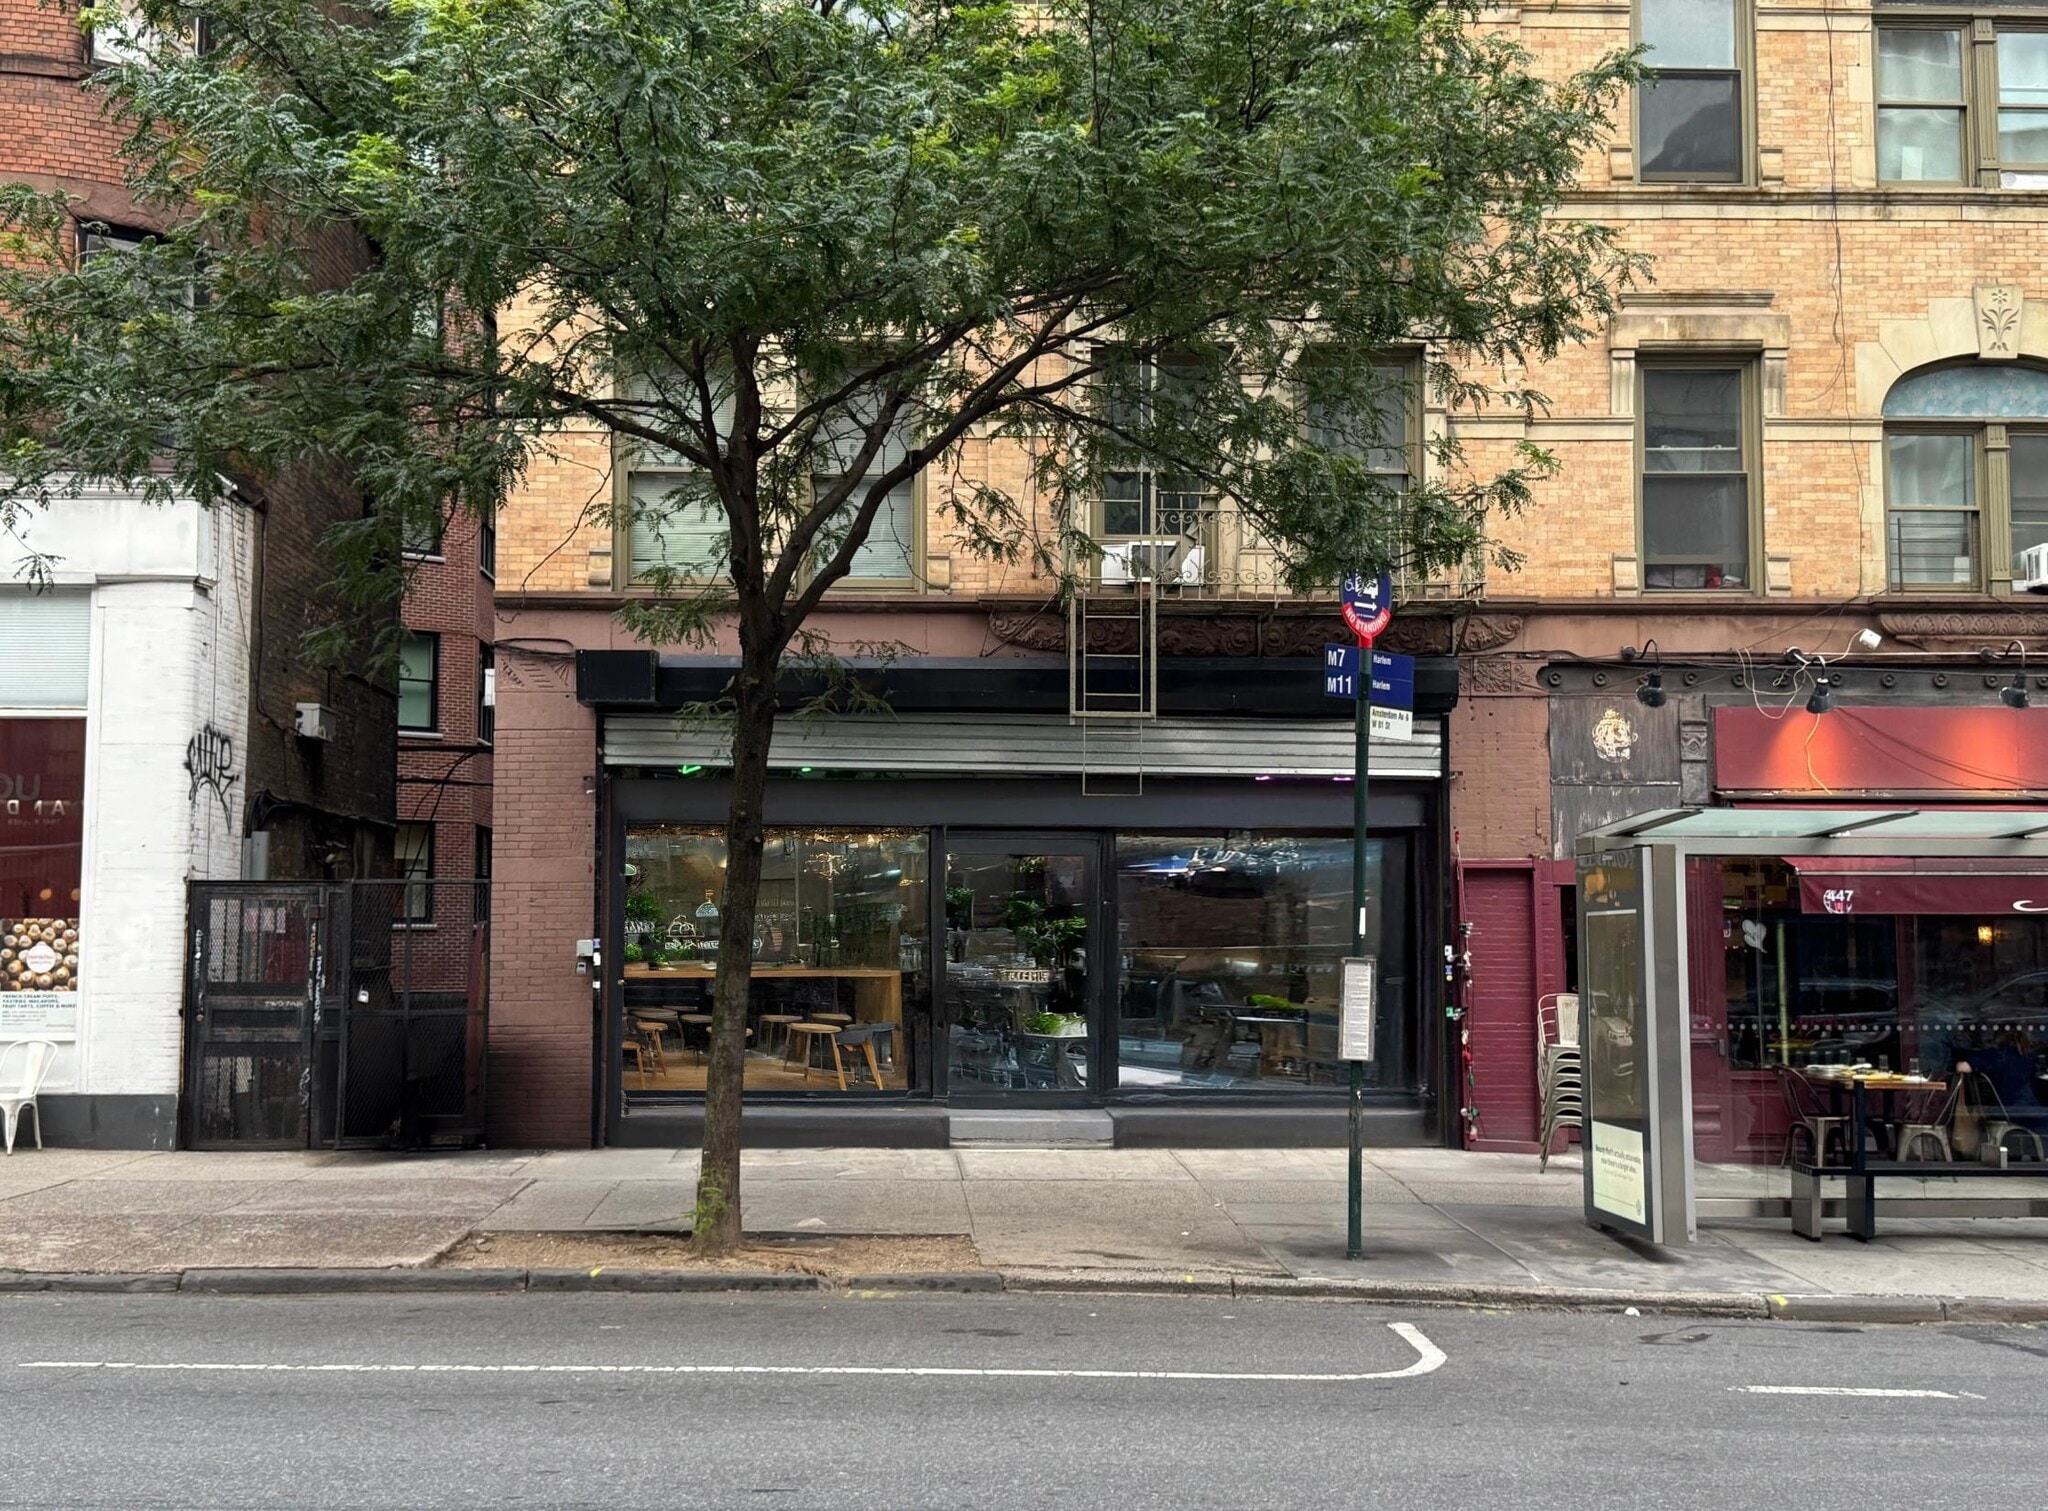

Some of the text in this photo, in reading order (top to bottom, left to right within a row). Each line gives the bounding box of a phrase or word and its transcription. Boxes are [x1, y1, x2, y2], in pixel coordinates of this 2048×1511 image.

[1345, 606, 1388, 634] NO STANDING
[1327, 648, 1346, 667] M7
[1373, 654, 1392, 666] Harlem
[1327, 674, 1352, 695] M11
[1372, 680, 1391, 691] Harlem
[1372, 708, 1397, 720] Amsterdam
[1827, 889, 1854, 901] 447
